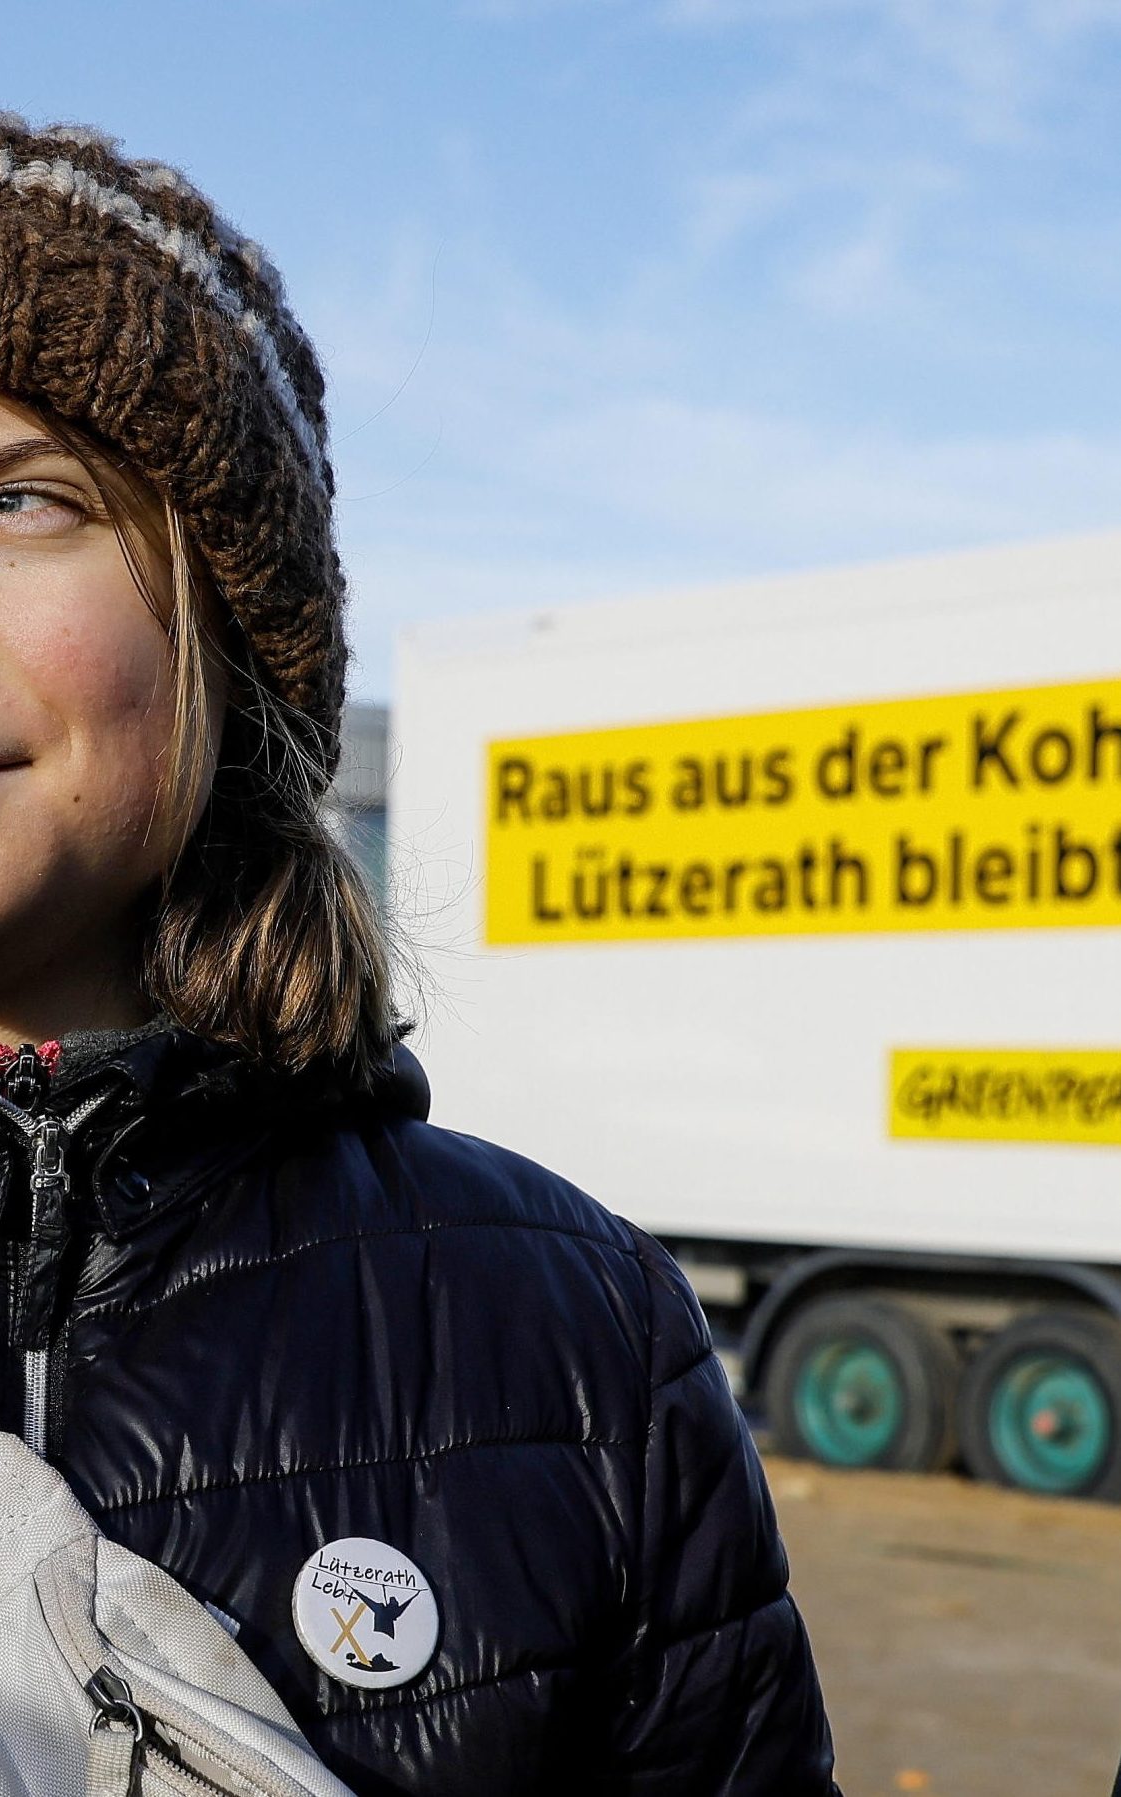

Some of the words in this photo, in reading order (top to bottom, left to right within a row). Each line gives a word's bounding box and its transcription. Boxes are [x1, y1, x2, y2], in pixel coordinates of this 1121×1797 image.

[495, 756, 652, 825] Raus
[670, 746, 795, 815] aus
[814, 722, 947, 800] der
[531, 840, 869, 922] Lützerath
[311, 1571, 359, 1606] Lebt
[318, 1550, 417, 1588] Lützerath
